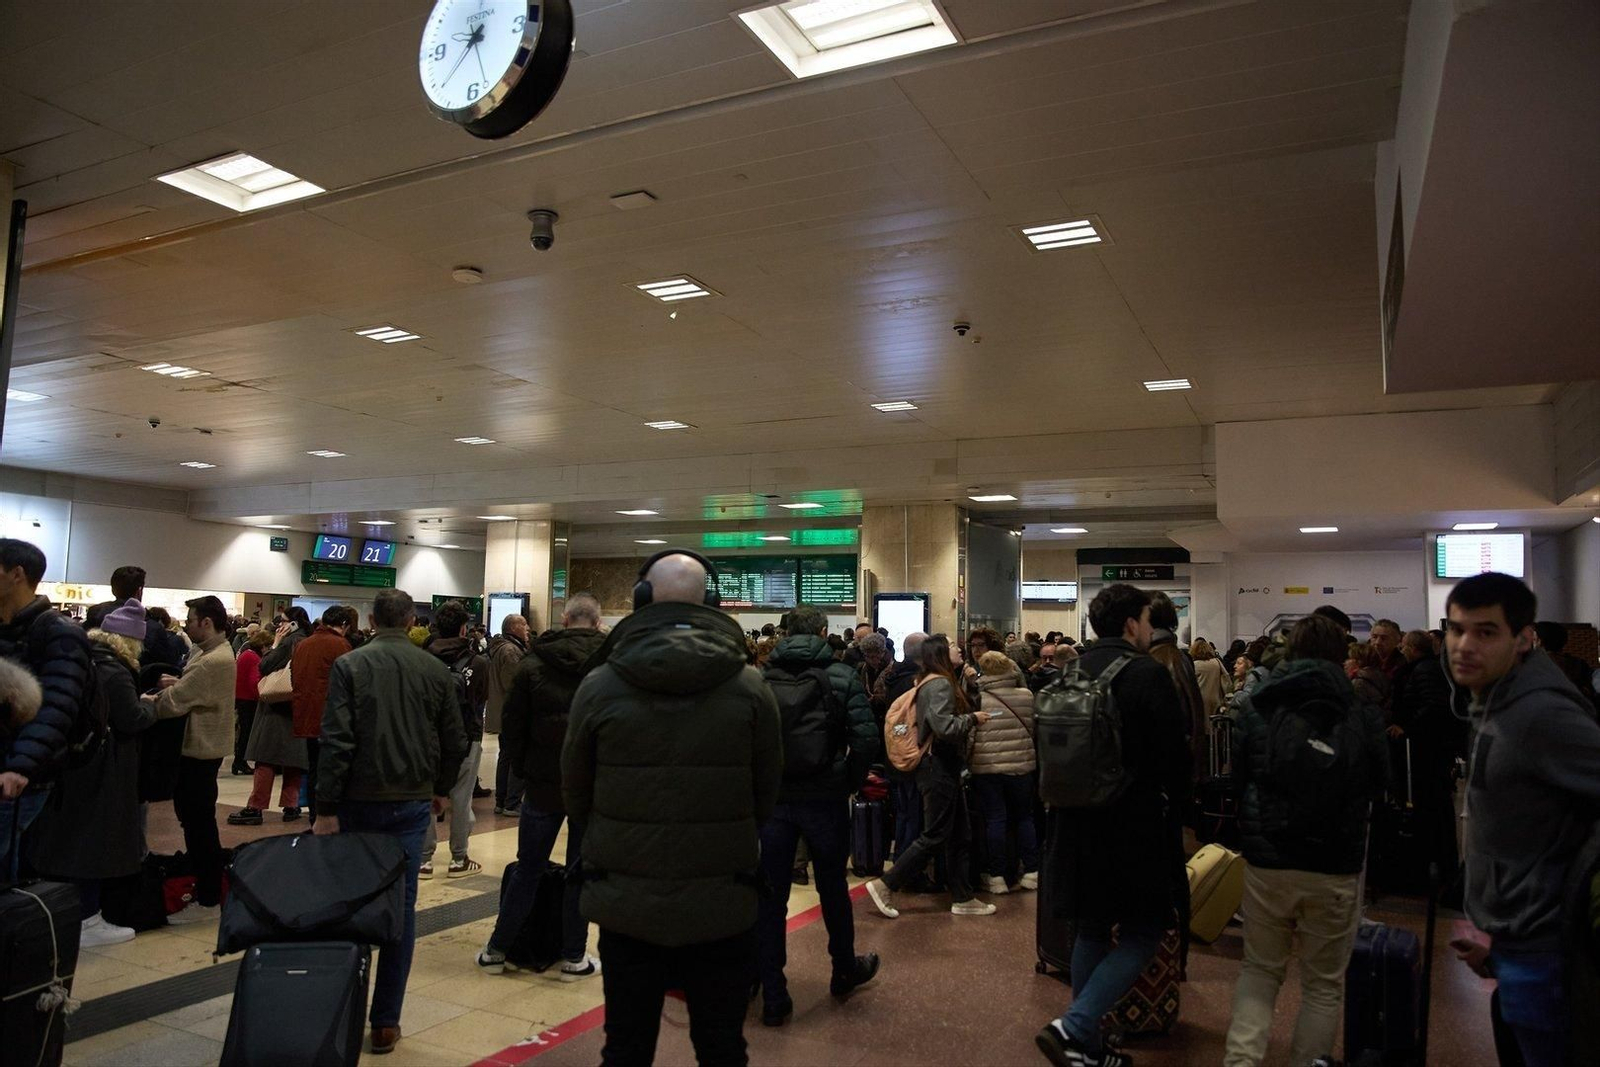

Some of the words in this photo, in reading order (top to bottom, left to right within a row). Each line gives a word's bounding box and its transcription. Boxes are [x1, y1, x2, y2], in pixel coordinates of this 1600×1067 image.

[466, 8, 495, 24] FESTINA
[512, 15, 526, 34] 3
[434, 43, 446, 61] 9
[466, 82, 479, 101] 6
[328, 543, 347, 559] 20
[364, 547, 380, 562] 21
